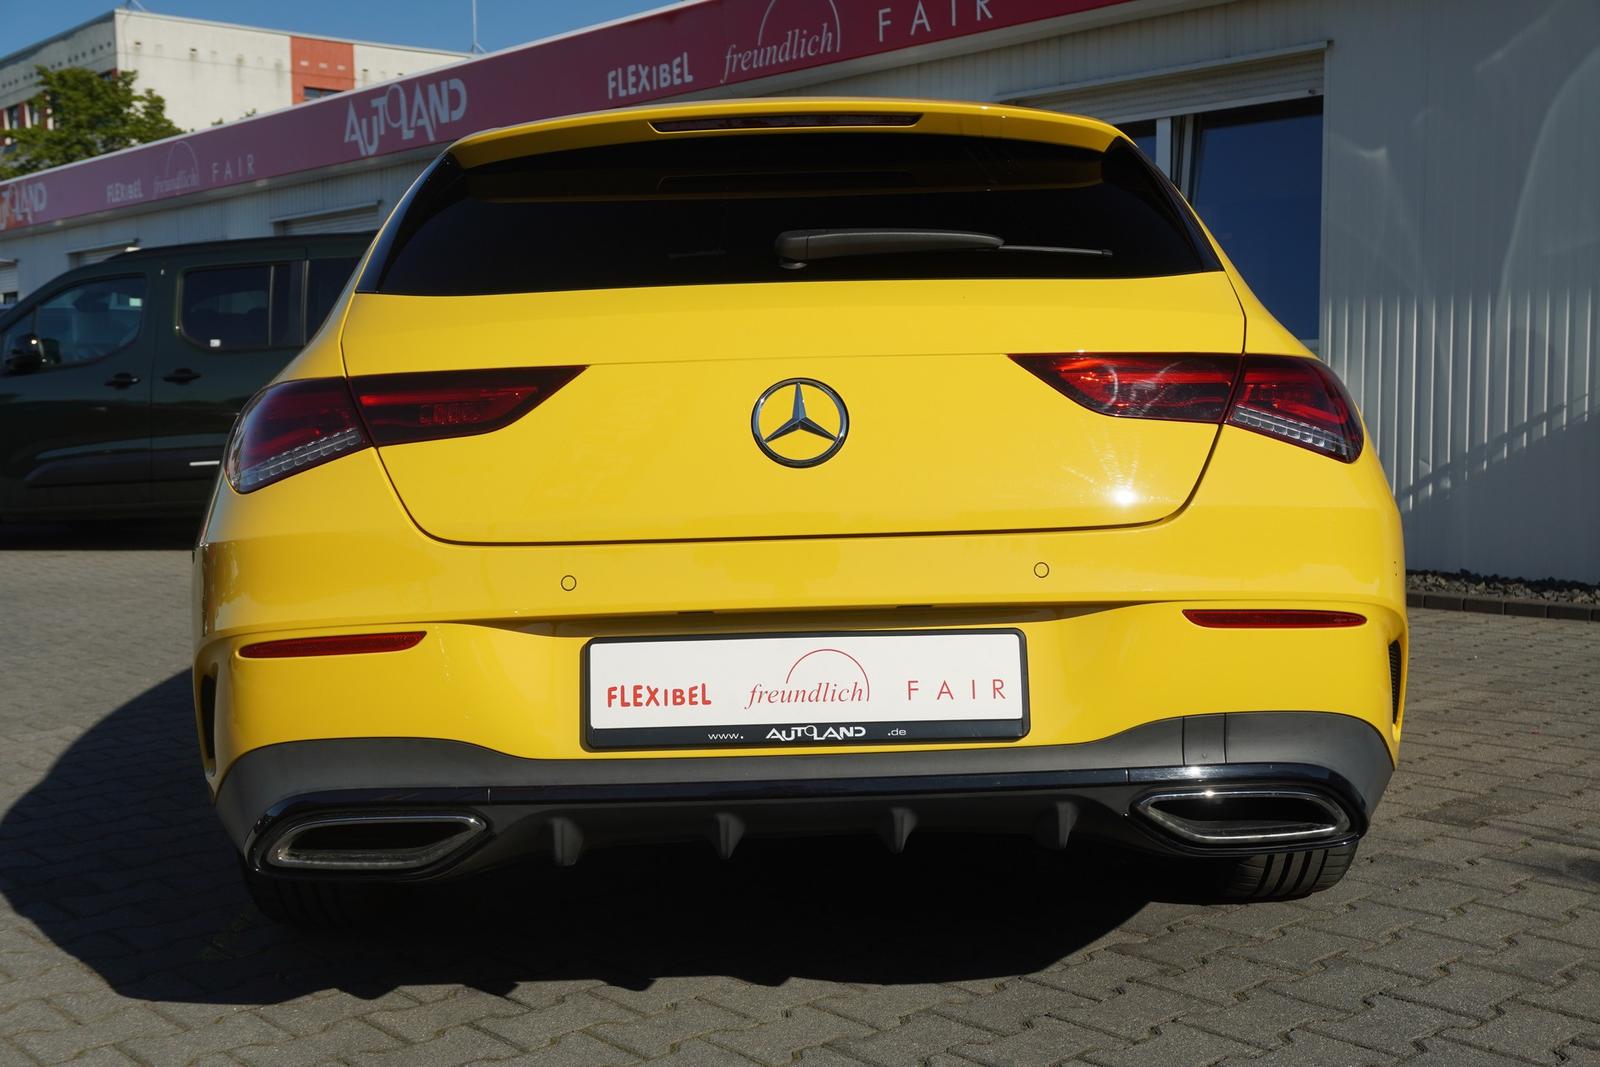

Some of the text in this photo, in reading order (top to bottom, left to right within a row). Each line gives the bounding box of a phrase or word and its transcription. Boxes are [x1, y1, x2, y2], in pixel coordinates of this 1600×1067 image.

[343, 0, 993, 156] AUTOLAND FLEXIBEL freundlich FAIR
[211, 153, 255, 184] FAIR
[607, 679, 1006, 710] FLEXIBEL freundlich FAIR
[708, 725, 906, 742] www. AUTOLAND .de
